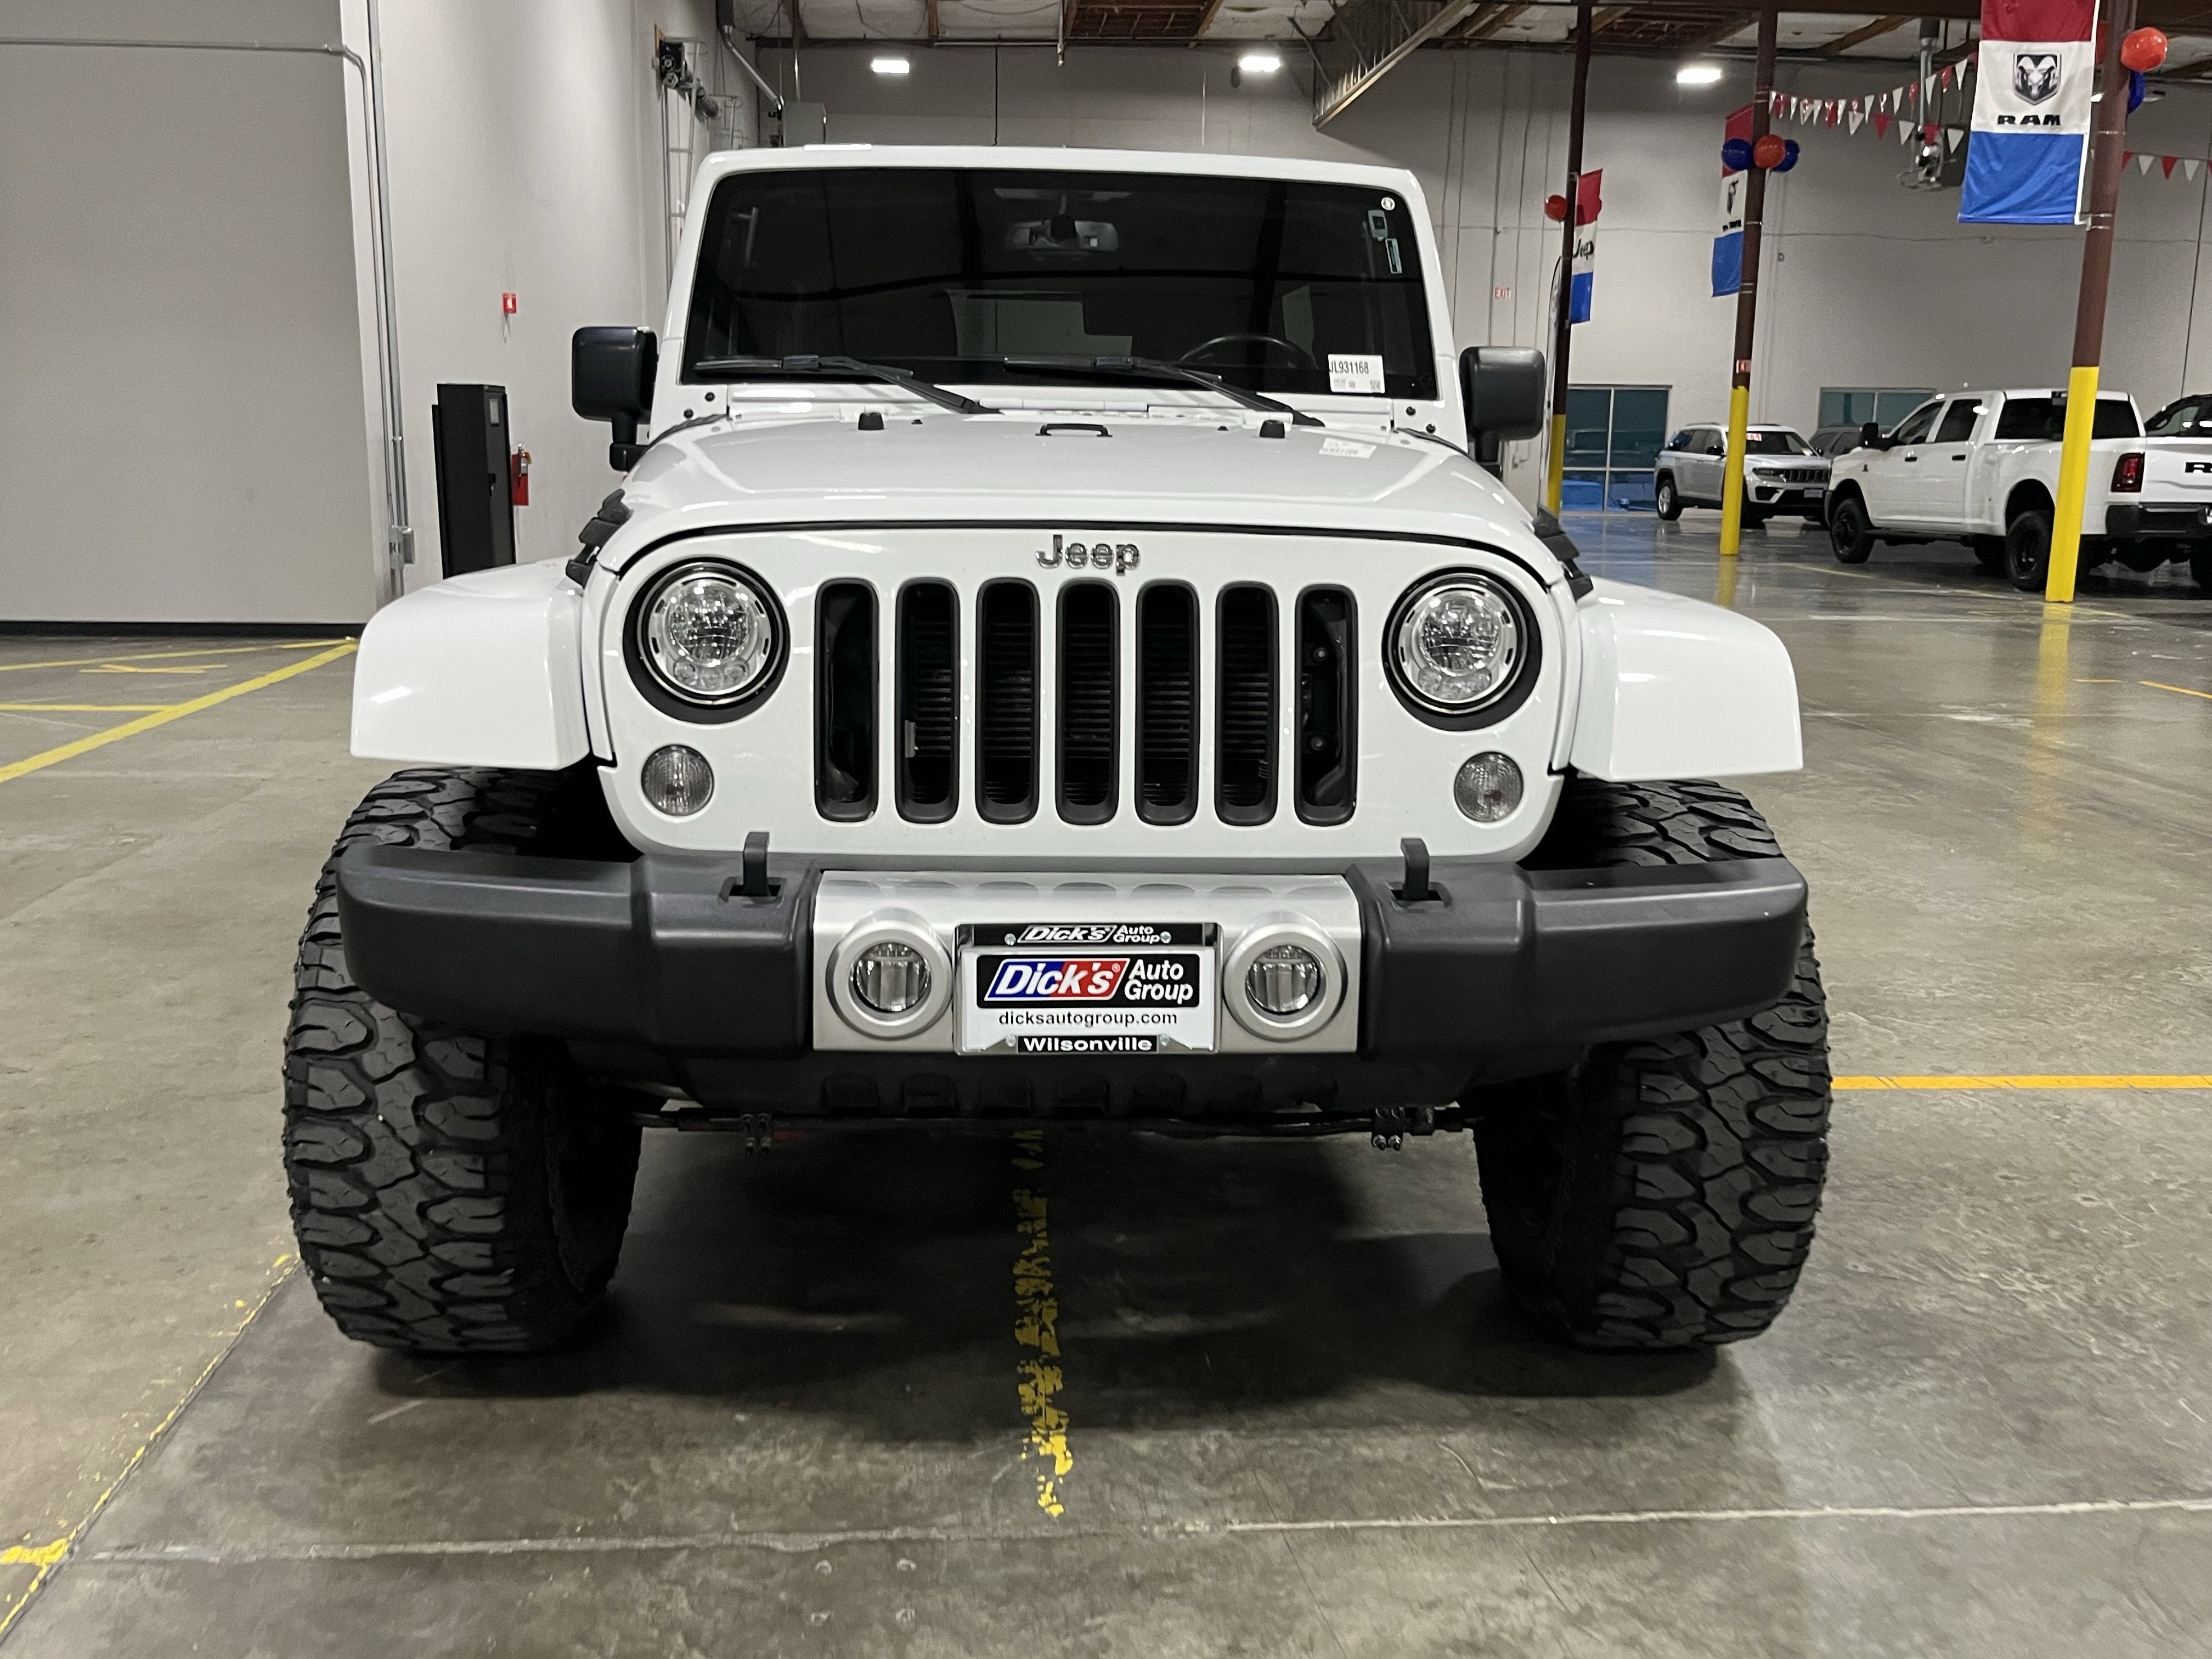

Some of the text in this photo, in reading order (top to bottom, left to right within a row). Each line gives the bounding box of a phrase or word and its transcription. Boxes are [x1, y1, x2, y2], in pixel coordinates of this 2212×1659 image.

[1997, 115, 2061, 126] RAM
[1329, 361, 1369, 374] JL931168
[1035, 534, 1141, 577] Jeep
[1024, 926, 1106, 940] Dick's
[1117, 925, 1154, 934] Auto
[1113, 933, 1160, 944] Group
[1128, 959, 1184, 980] Auto
[995, 962, 1114, 995] Dick's
[1125, 979, 1193, 1005] Group
[999, 1012, 1177, 1027] dicksautogroup.com
[1024, 1037, 1152, 1051] Wilsonville
